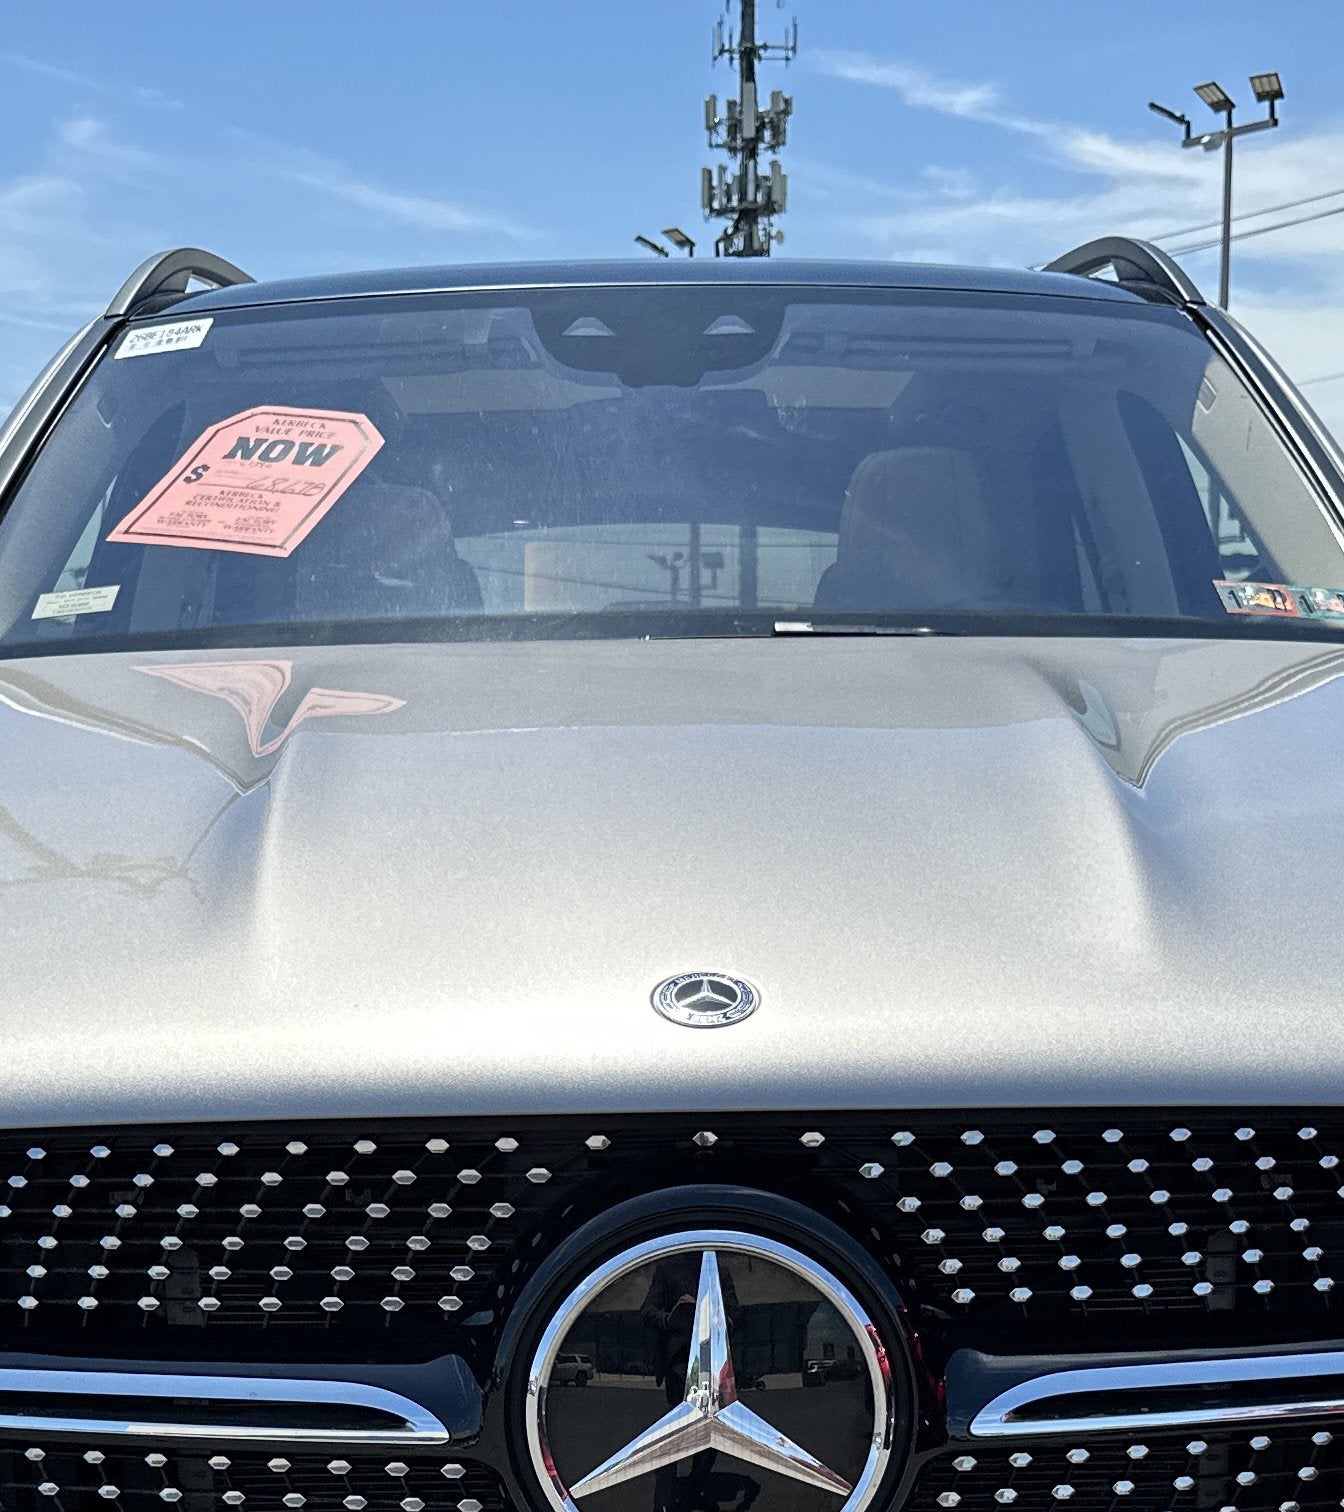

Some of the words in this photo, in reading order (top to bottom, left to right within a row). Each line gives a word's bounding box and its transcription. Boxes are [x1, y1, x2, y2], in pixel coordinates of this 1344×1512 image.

[255, 425, 293, 436] VALUE
[298, 429, 336, 439] PRICE
[222, 436, 344, 467] NOW
[183, 464, 210, 484] $
